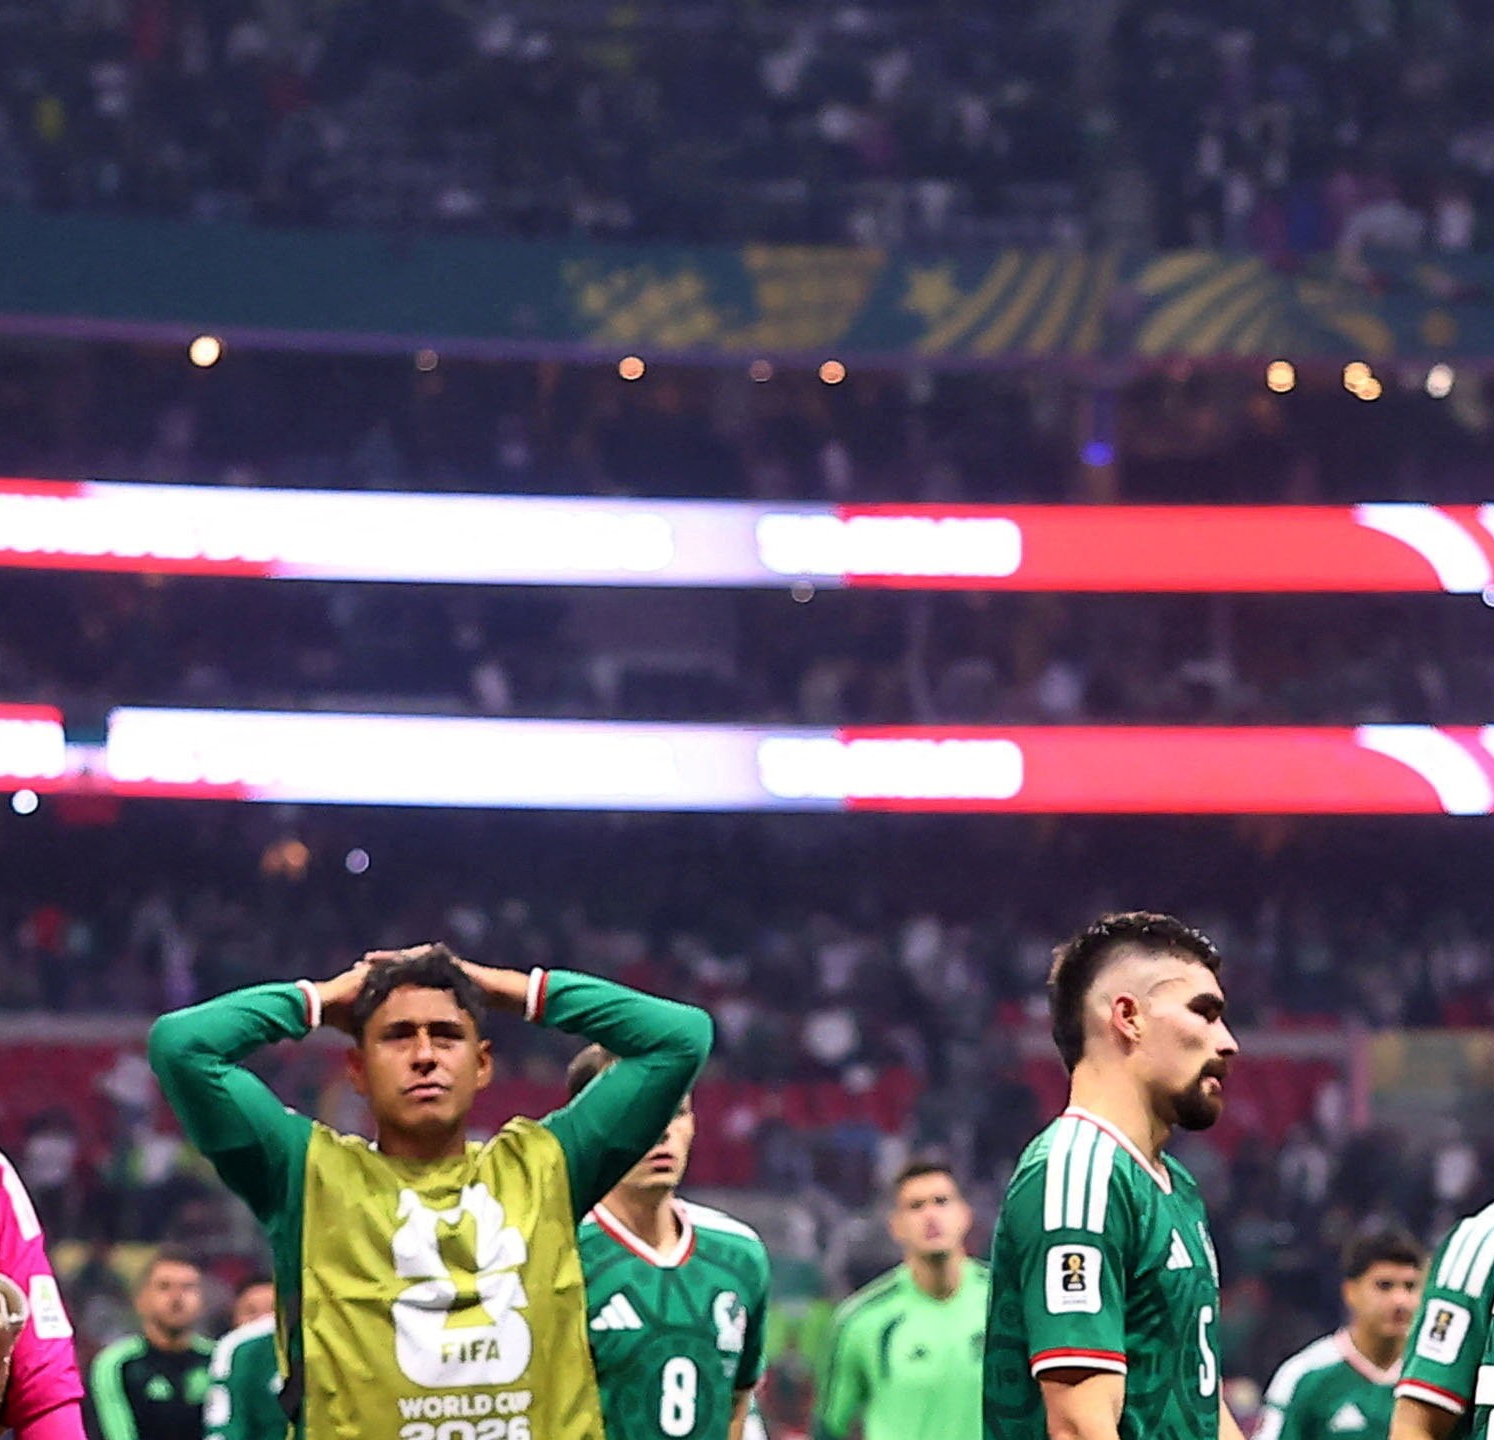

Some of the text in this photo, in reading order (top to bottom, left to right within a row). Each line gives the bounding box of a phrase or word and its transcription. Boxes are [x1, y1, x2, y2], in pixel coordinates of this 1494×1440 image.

[441, 1338, 501, 1364] FIFA
[398, 1389, 533, 1420] WORLD CUP
[659, 1356, 698, 1438] 8
